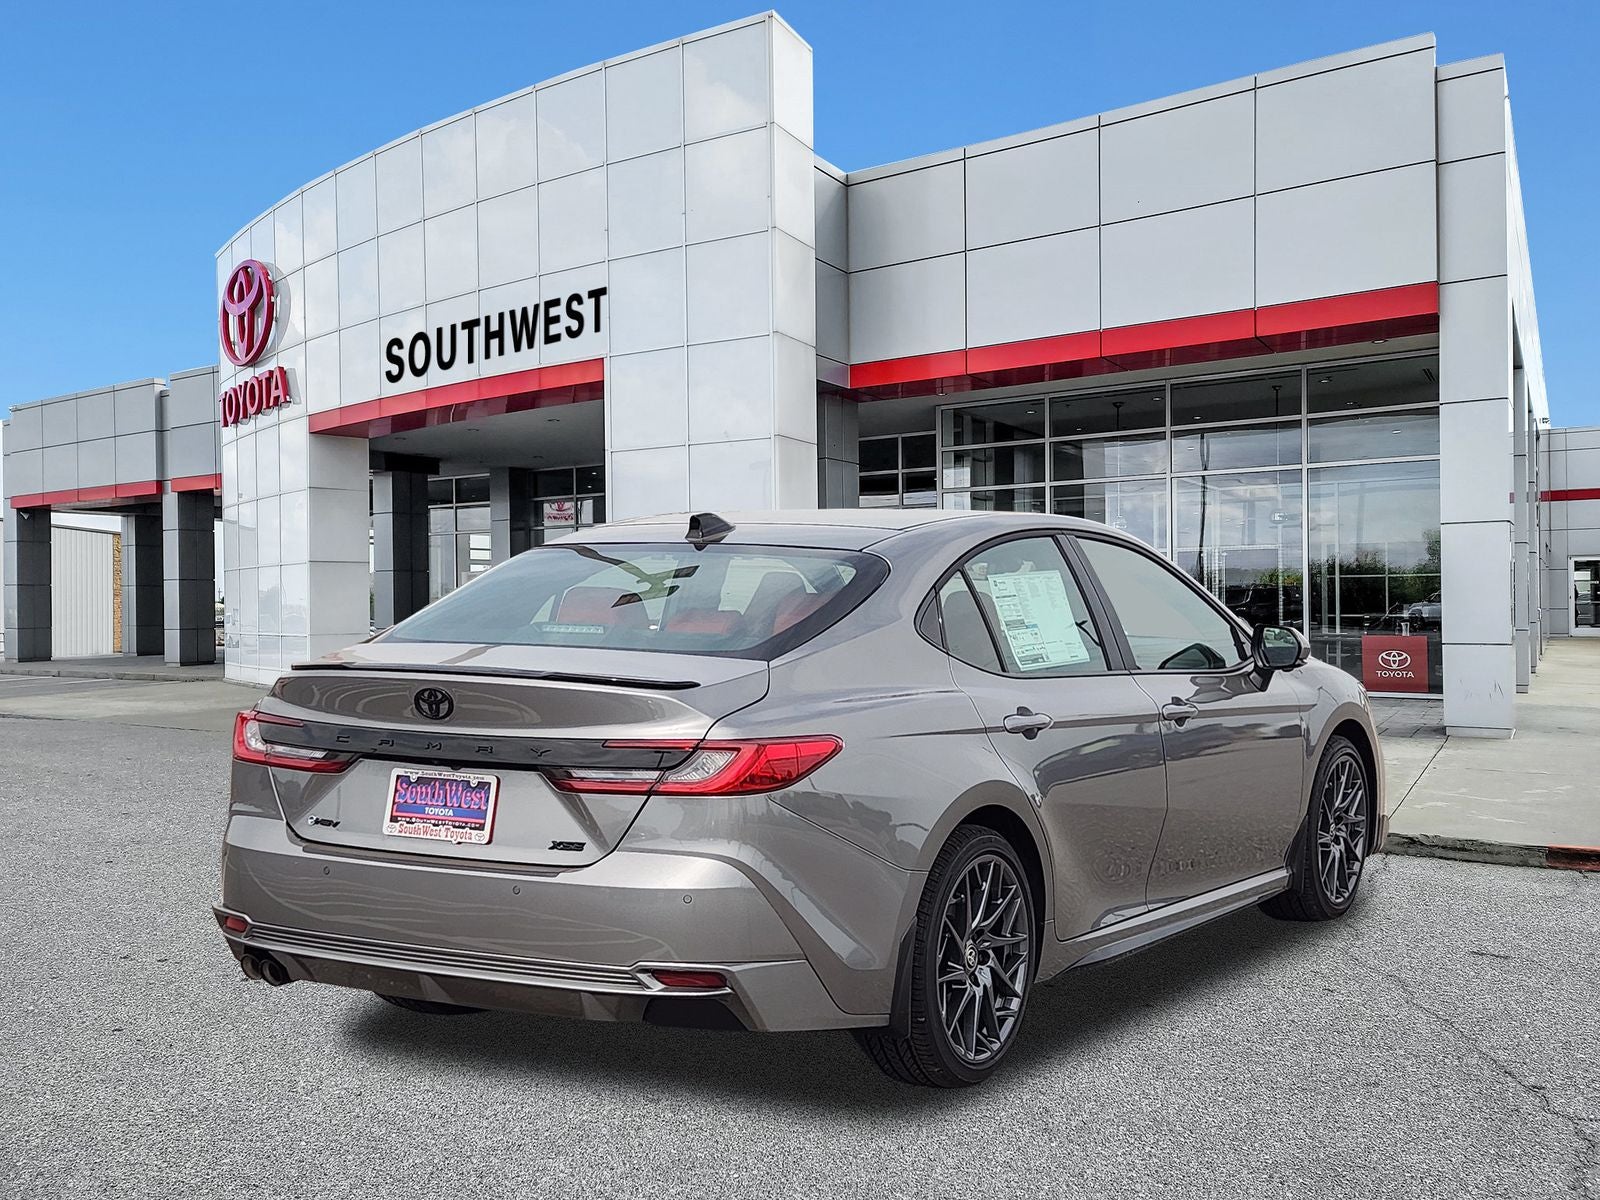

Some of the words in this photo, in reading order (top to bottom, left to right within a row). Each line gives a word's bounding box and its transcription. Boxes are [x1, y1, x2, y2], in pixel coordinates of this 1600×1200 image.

[385, 286, 607, 384] SOUTHWEST
[218, 366, 289, 428] TOYOTA
[1375, 670, 1415, 678] TOYOTA
[335, 735, 553, 757] CAMRY
[425, 807, 454, 817] TOYOTA
[444, 827, 473, 841] Toyota
